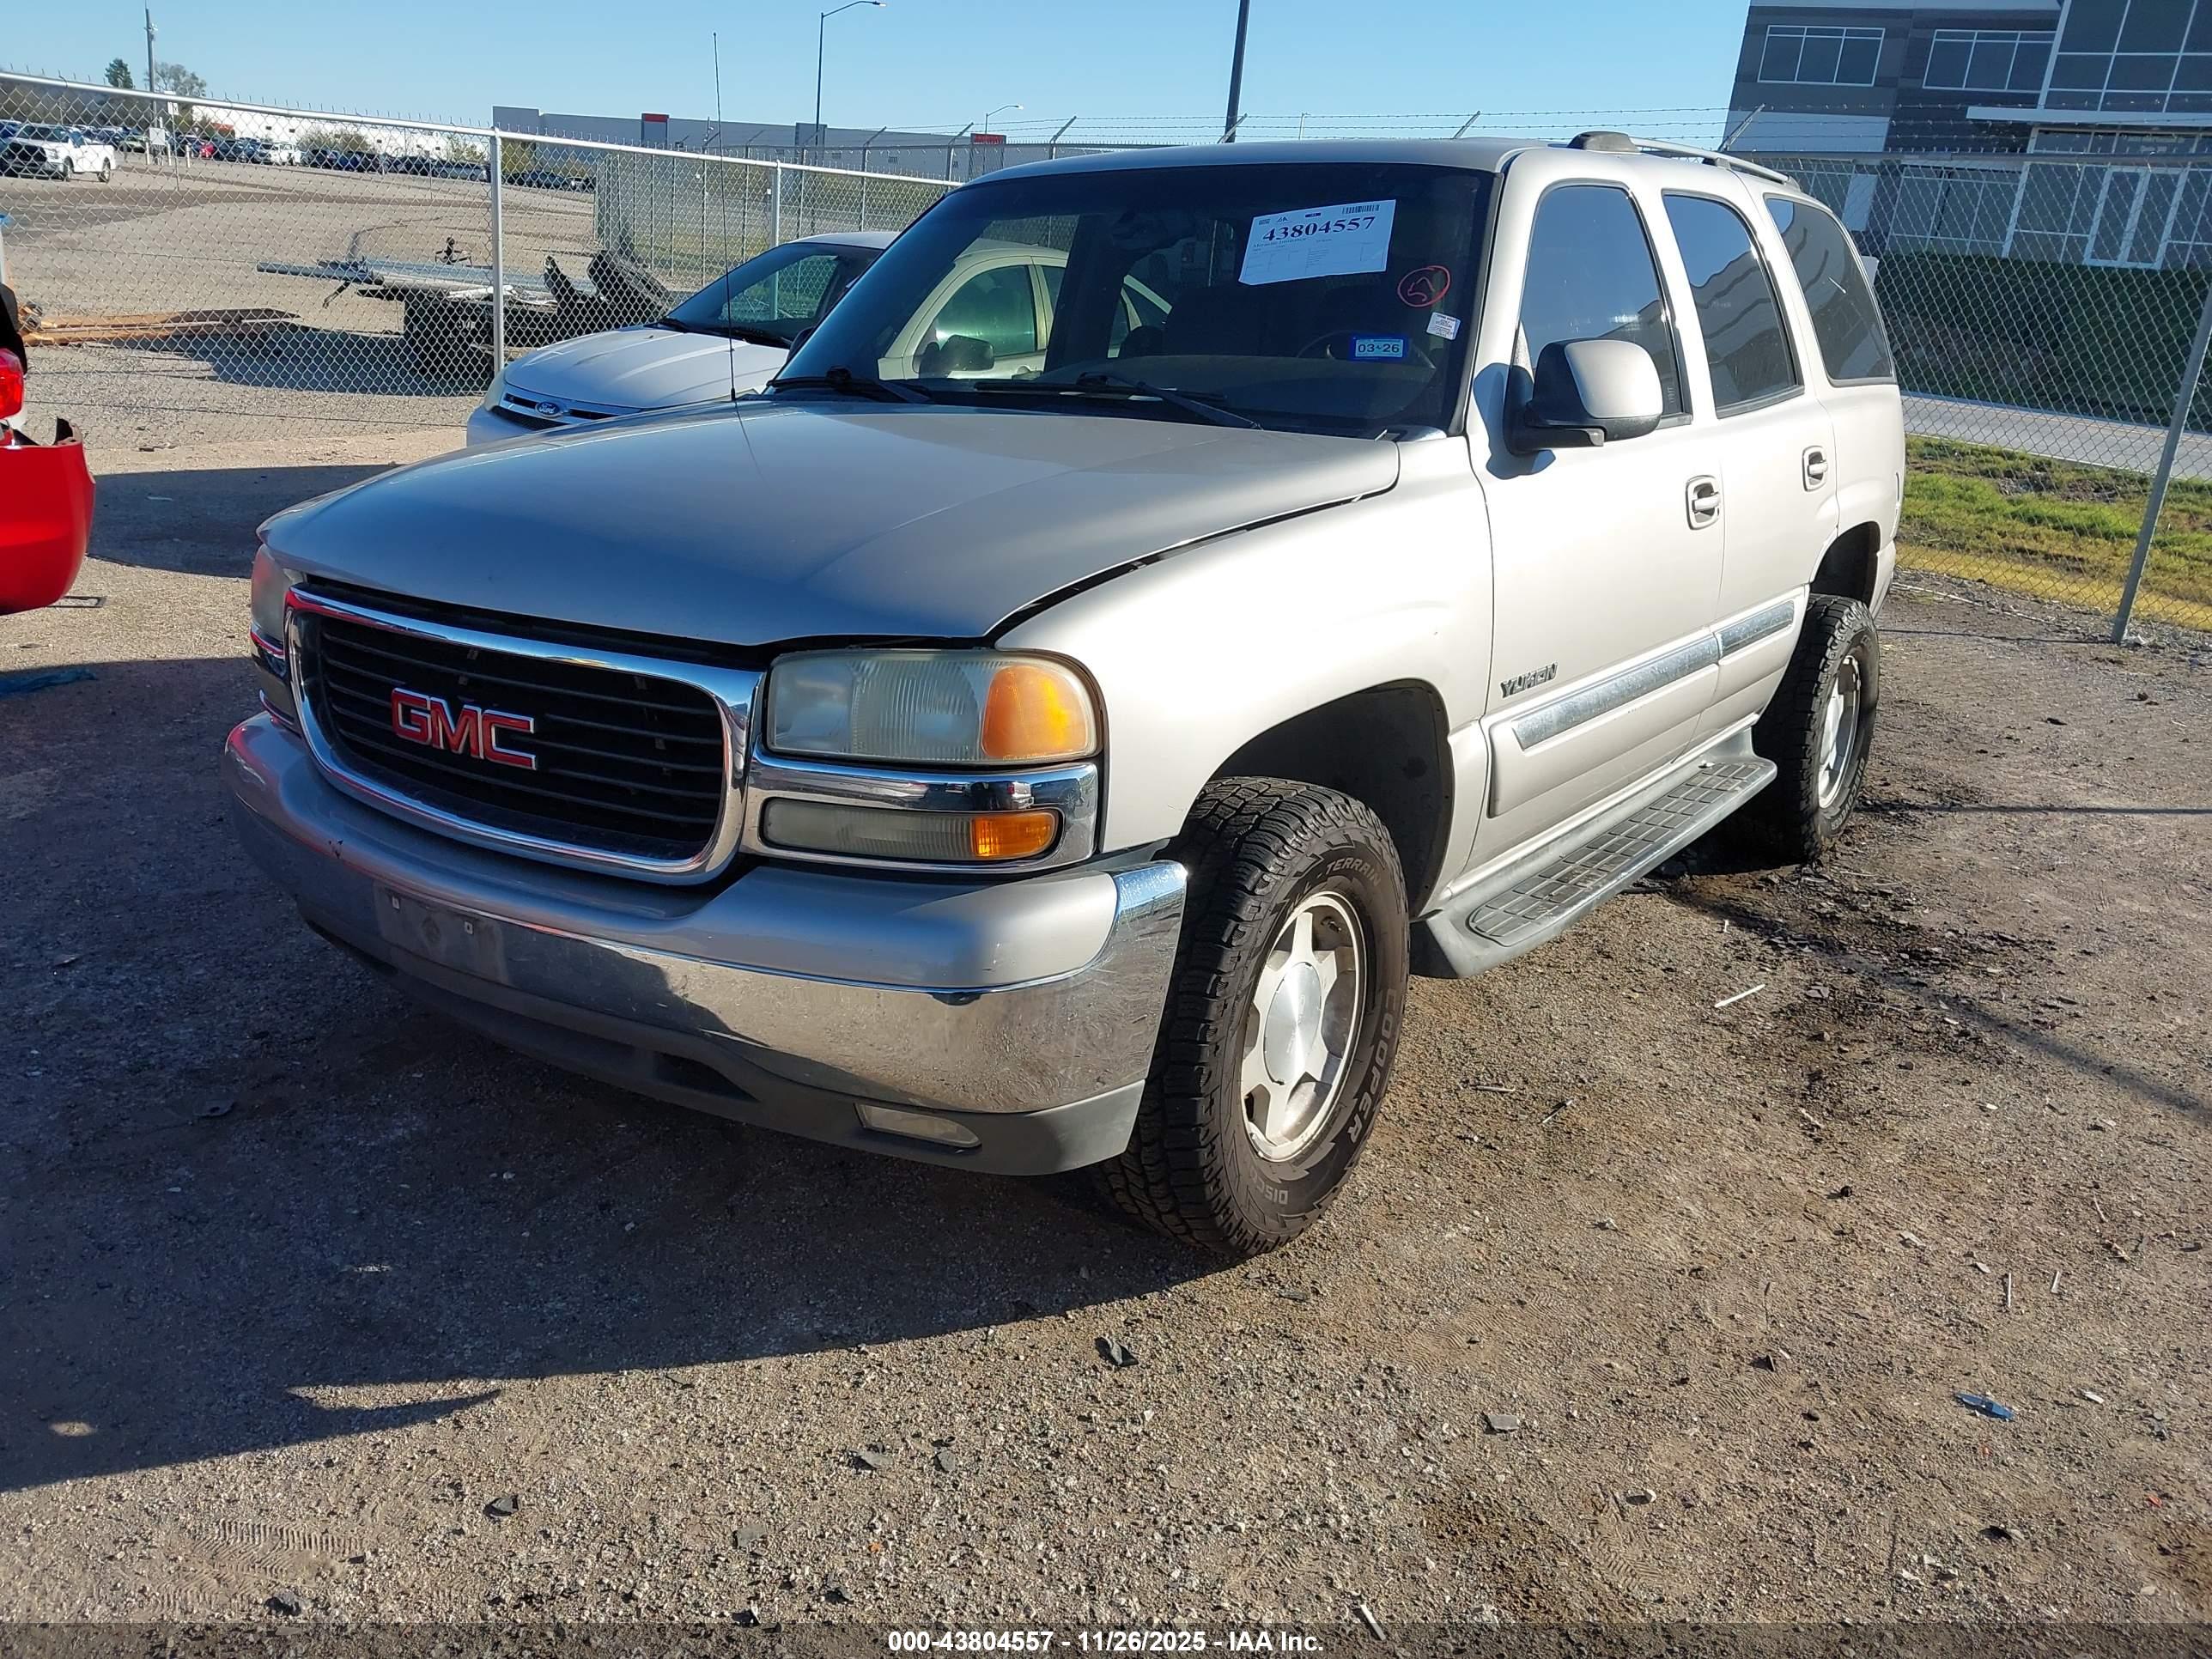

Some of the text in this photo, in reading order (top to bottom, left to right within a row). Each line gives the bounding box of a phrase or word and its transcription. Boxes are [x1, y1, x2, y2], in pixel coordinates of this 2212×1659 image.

[1262, 216, 1376, 241] 43804557
[1358, 343, 1400, 354] 03 26
[538, 403, 556, 414] Ford
[1500, 662, 1558, 698] YUKON
[392, 687, 537, 770] GMC
[1325, 857, 1382, 887] TERRAIN
[1347, 988, 1398, 1144] COOPER
